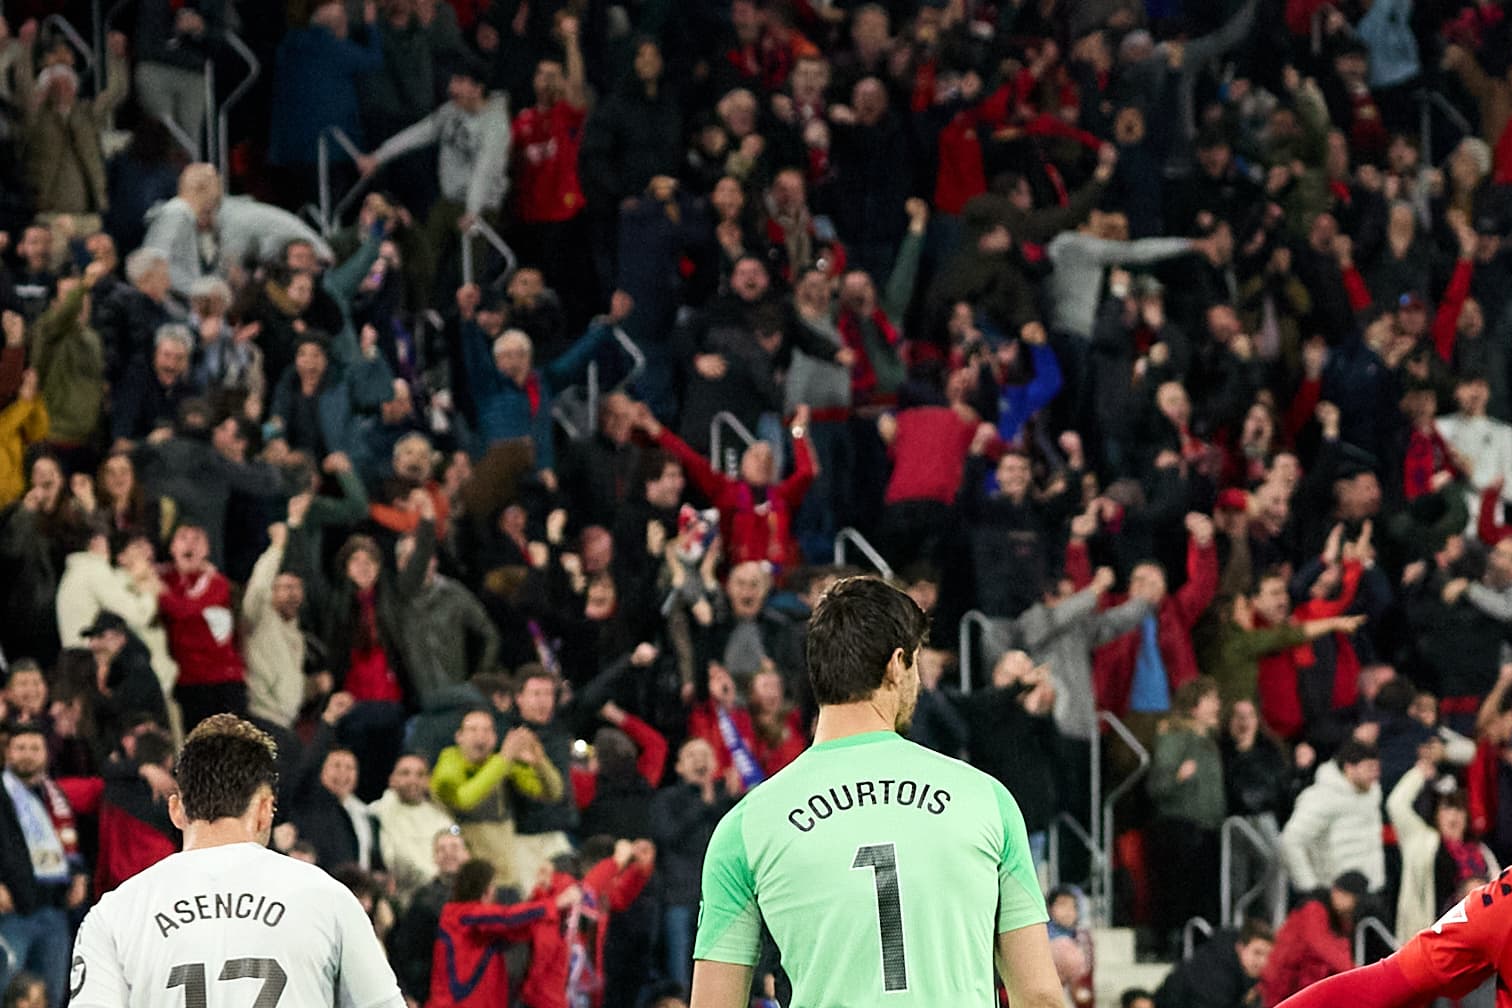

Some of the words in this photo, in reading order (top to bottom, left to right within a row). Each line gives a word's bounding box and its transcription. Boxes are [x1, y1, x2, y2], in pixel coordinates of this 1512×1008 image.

[788, 780, 951, 833] COURTOIS
[154, 893, 286, 938] ASENCIO
[851, 842, 908, 992] 1
